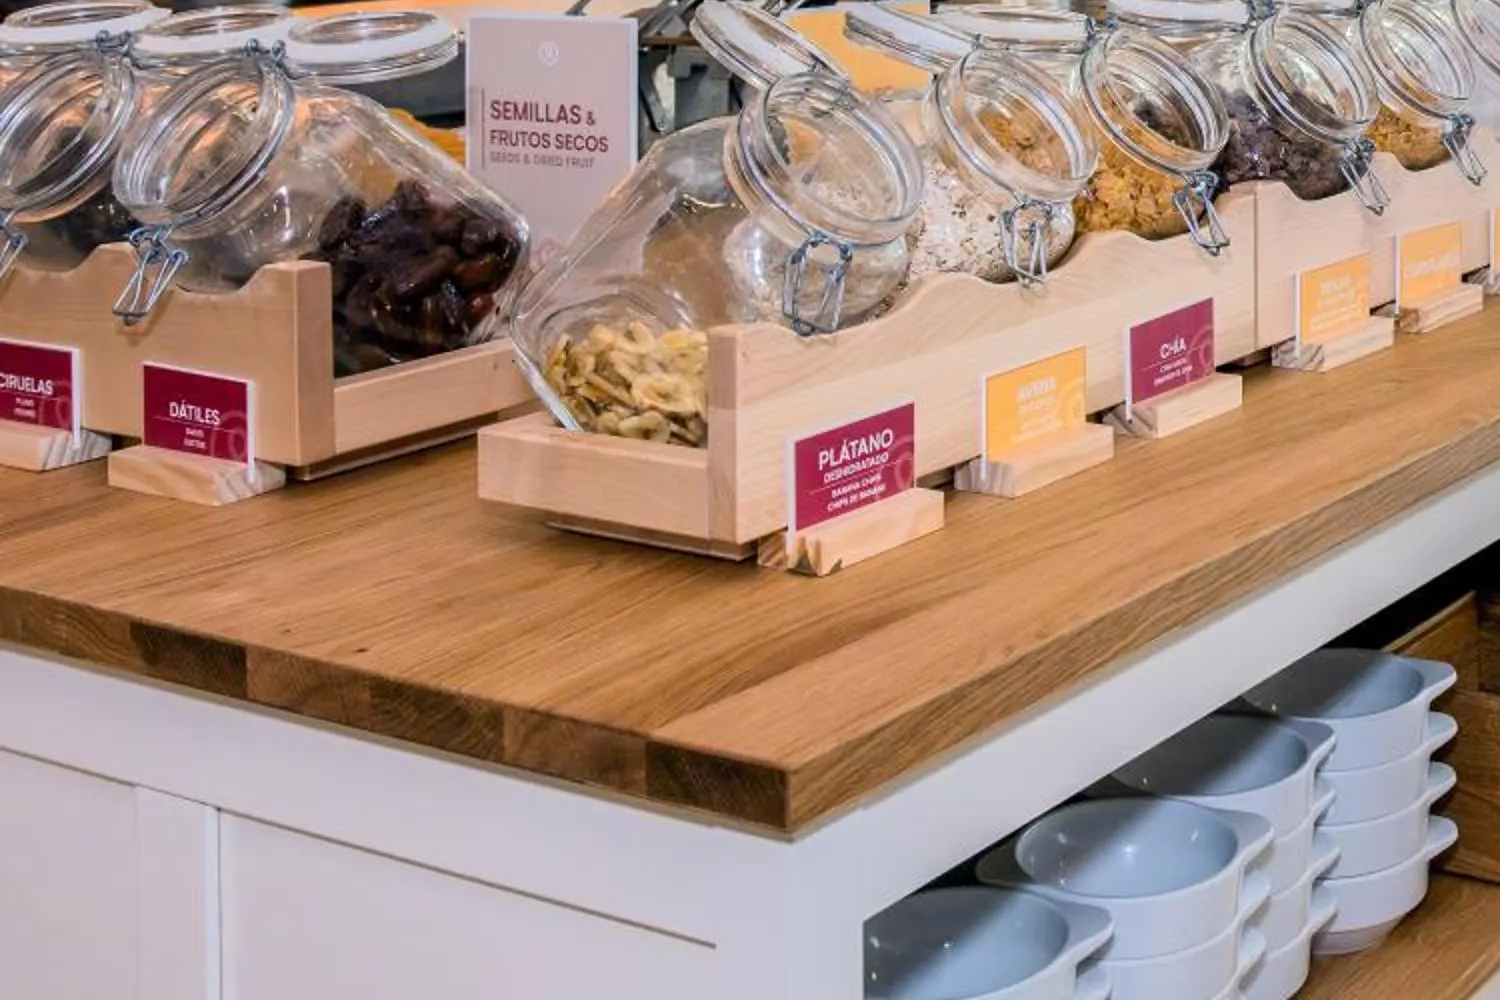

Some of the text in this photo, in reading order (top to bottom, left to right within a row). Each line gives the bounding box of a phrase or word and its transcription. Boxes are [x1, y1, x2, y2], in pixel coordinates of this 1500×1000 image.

[490, 100, 581, 124] SEMILLAS
[490, 129, 609, 152] FRUTOS SECOS
[168, 398, 220, 425] DÁTILES
[818, 428, 893, 470] PLÁTANO
